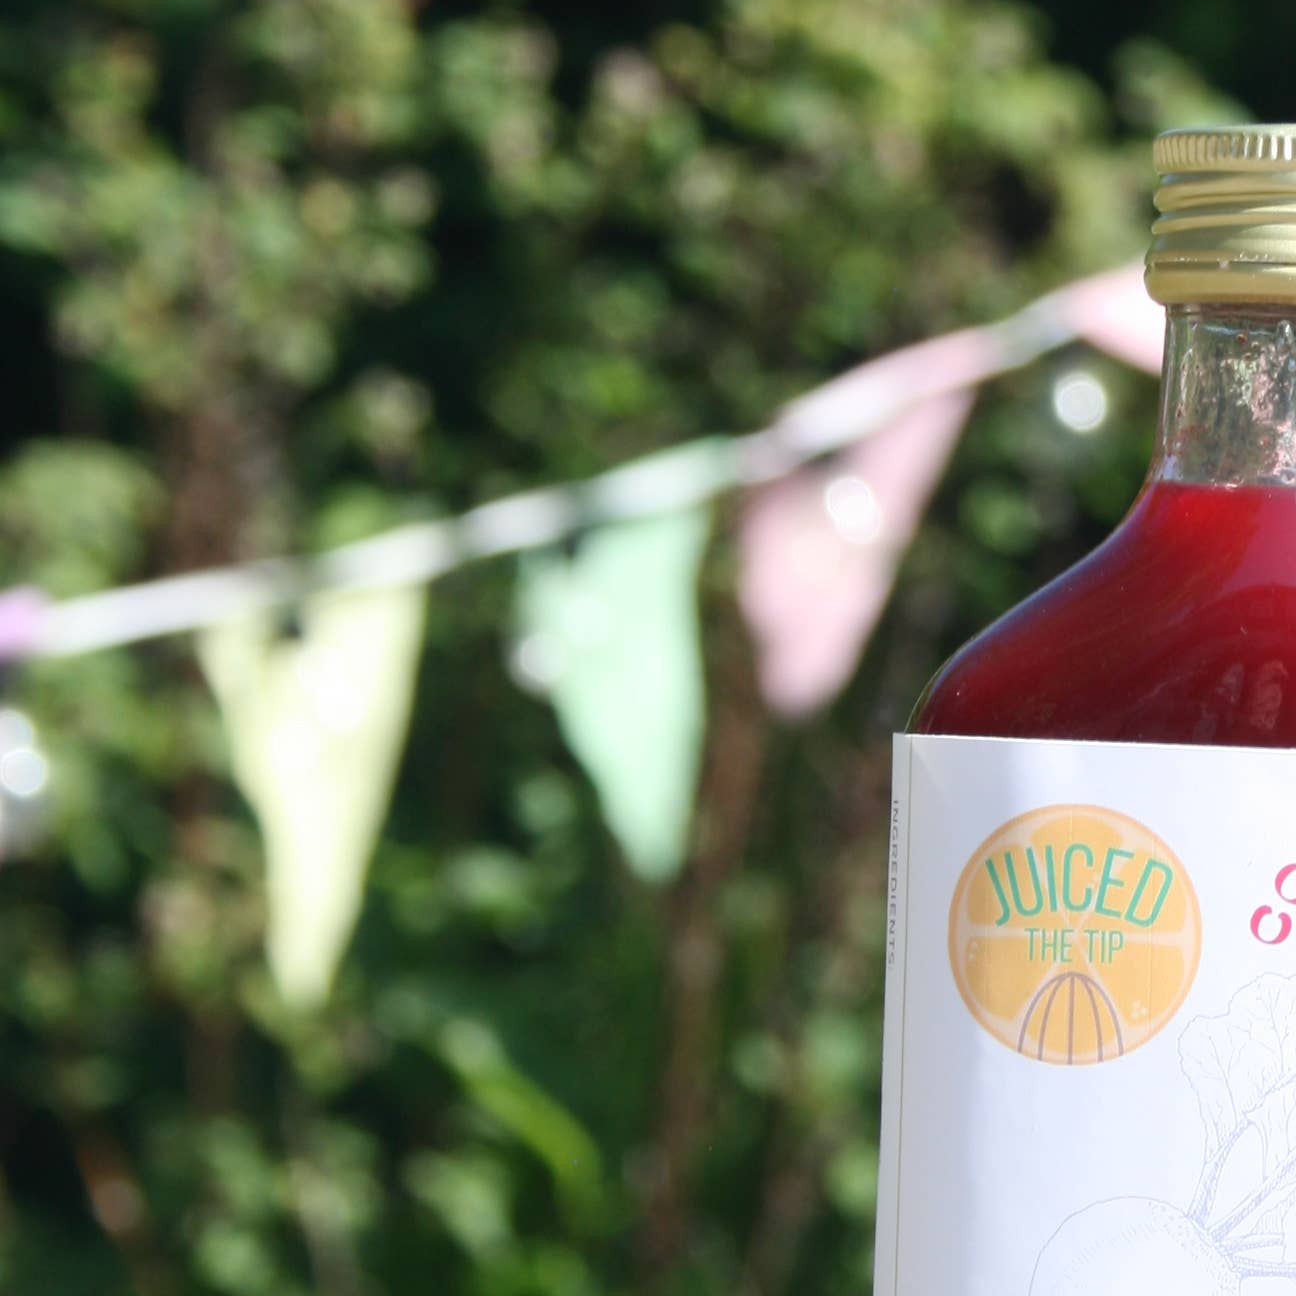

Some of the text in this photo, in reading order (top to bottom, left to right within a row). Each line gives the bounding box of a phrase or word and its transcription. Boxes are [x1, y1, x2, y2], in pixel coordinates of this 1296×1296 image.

[985, 843, 1173, 928] JUICED
[1025, 928, 1124, 964] THE TIP
